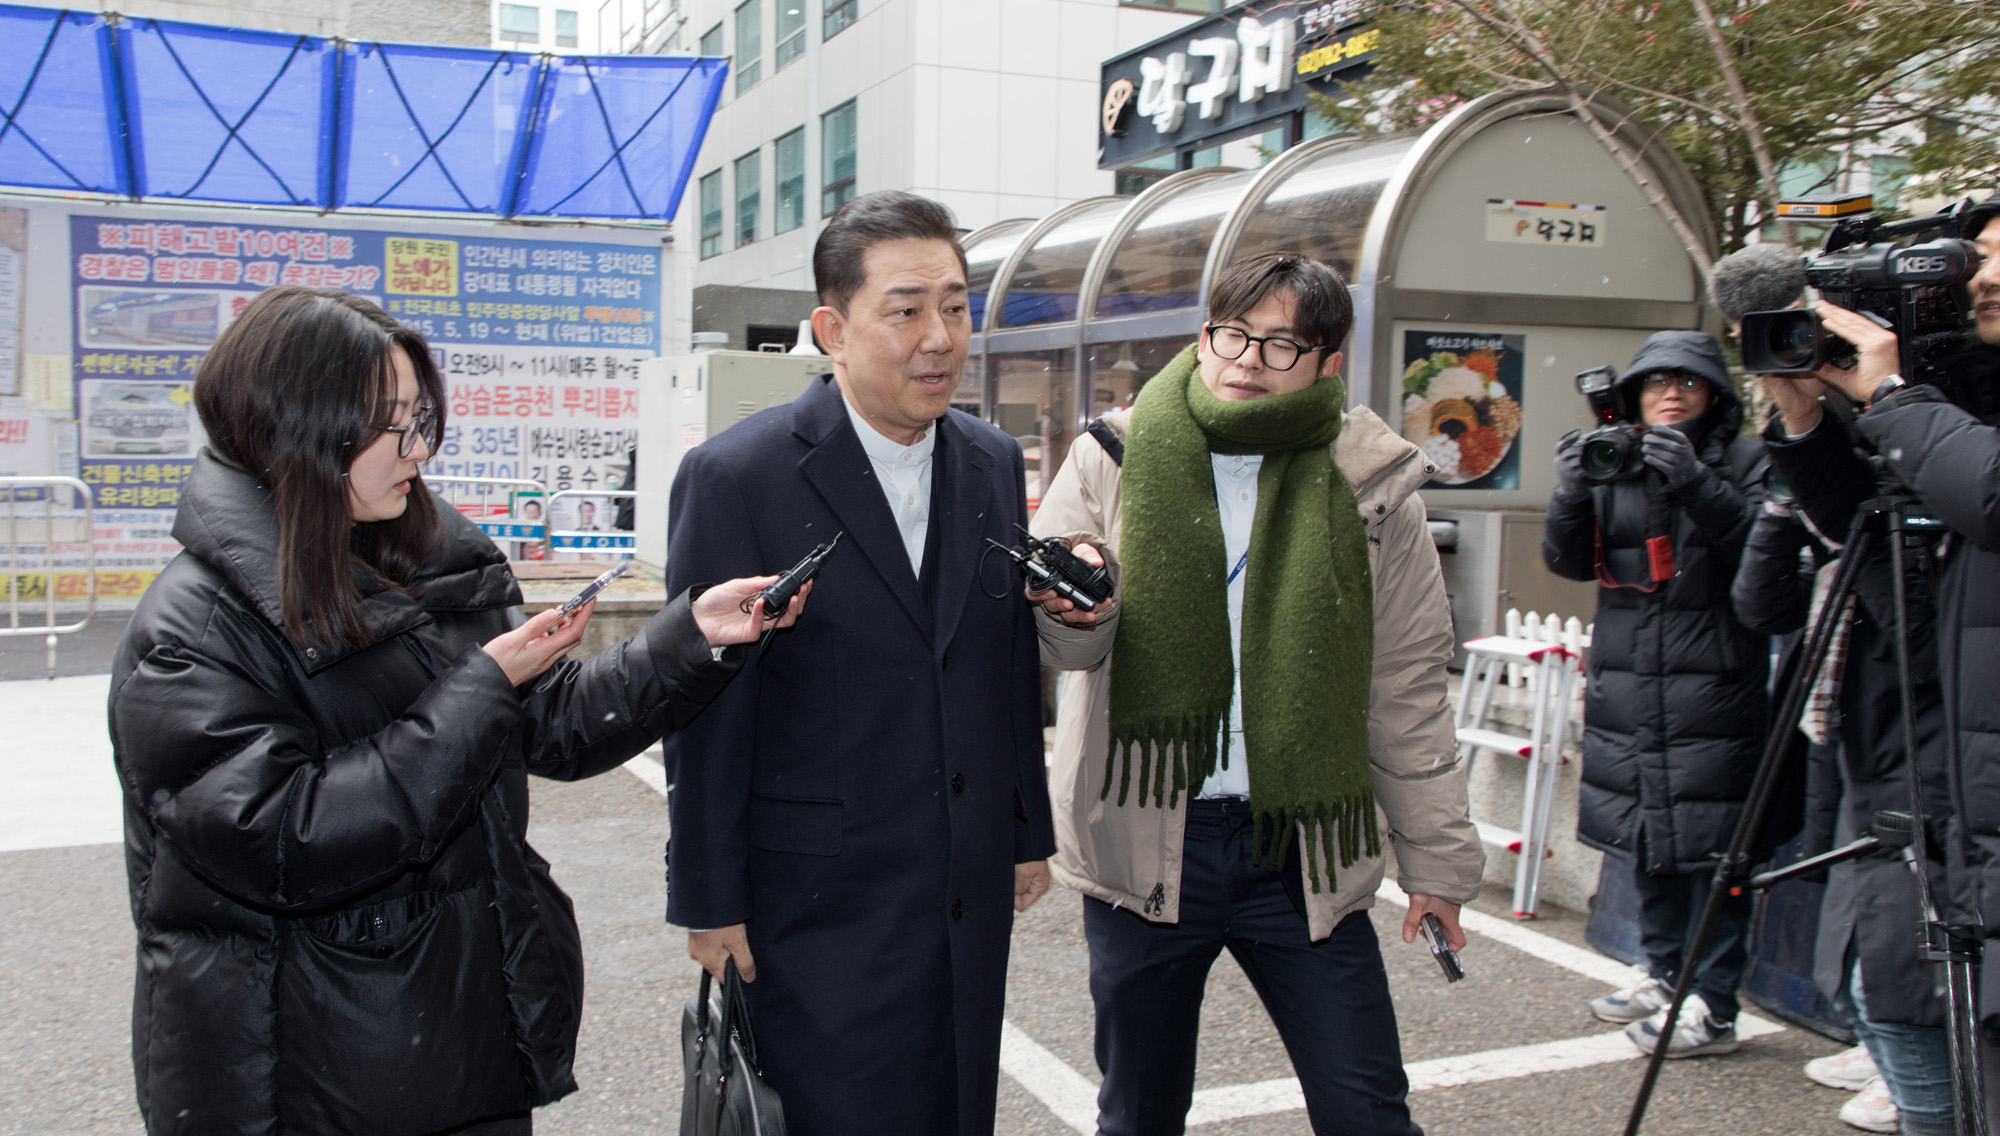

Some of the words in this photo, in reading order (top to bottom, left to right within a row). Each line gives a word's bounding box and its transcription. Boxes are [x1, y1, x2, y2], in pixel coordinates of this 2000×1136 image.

[79, 253, 148, 280] 경찰은
[153, 257, 242, 284] 범인들을
[281, 263, 381, 289] 못잡는가?
[391, 256, 451, 278] 노예가
[463, 245, 527, 270] 인간냄새
[531, 249, 593, 272] 의리없는
[596, 251, 656, 276] 정치인은
[1898, 255, 1948, 274] KBS
[463, 271, 512, 294] 당대표
[581, 276, 642, 301] 자격없다
[444, 320, 462, 338] 5.
[468, 321, 490, 339] 19
[514, 322, 549, 342] 현재
[450, 353, 504, 377] 오전9시
[450, 384, 555, 418] 상습돈공천
[471, 425, 520, 457] 35년
